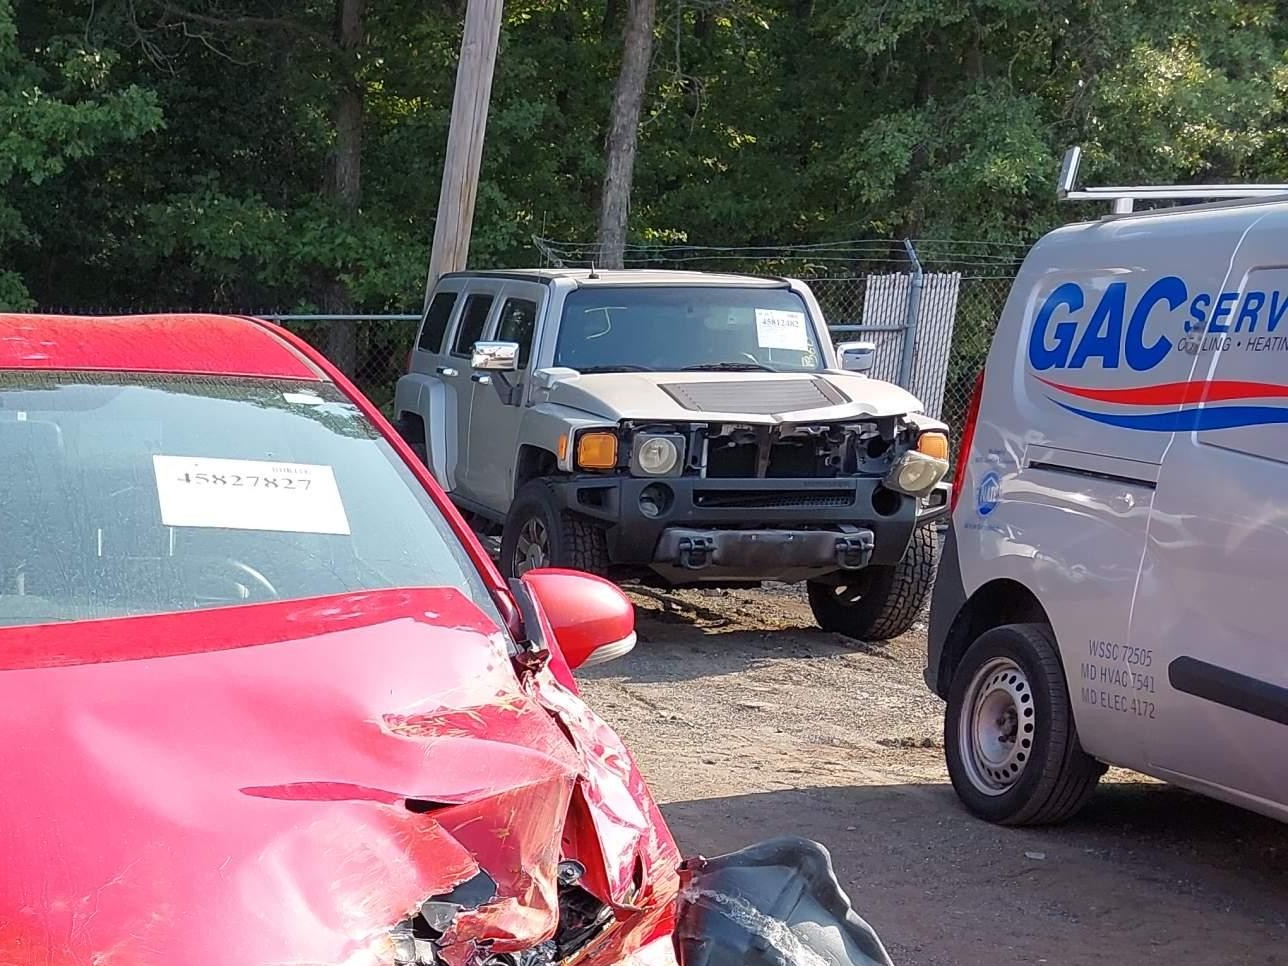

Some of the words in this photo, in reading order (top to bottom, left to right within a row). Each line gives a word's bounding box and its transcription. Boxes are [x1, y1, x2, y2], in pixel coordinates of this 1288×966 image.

[1029, 276, 1188, 371] GAC
[1177, 337, 1233, 352] CLING
[177, 472, 312, 491] 45827827
[1089, 639, 1119, 661] WSSC
[1122, 645, 1153, 667] 72505
[1081, 663, 1097, 681] MD
[1100, 666, 1128, 688] HVAC
[1131, 672, 1155, 694] 7541
[1081, 687, 1097, 705] MD
[1100, 691, 1128, 713] ELEC
[1131, 698, 1155, 720] 4172
